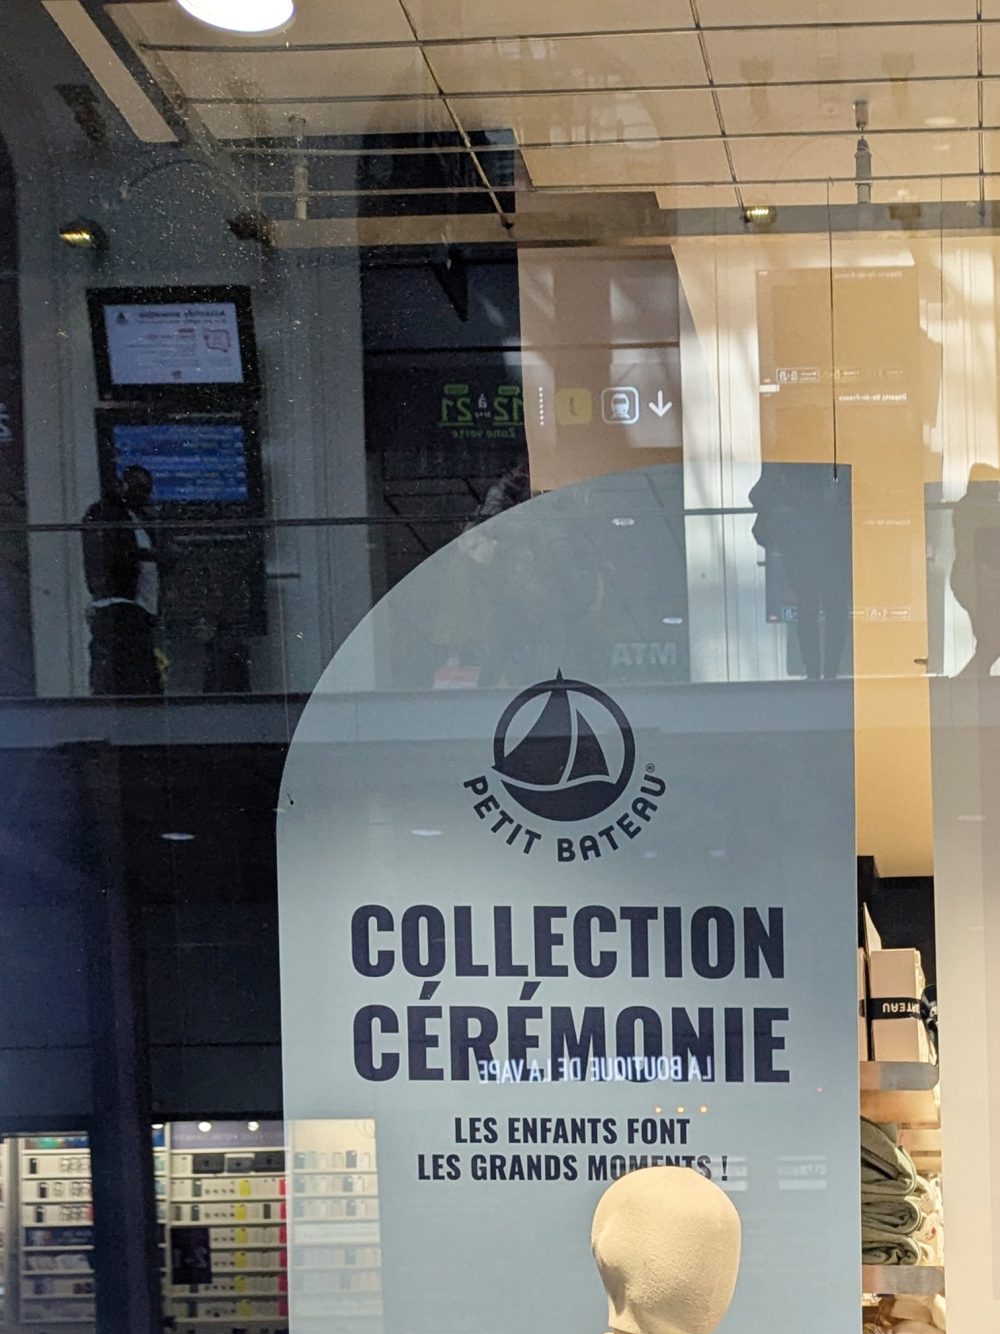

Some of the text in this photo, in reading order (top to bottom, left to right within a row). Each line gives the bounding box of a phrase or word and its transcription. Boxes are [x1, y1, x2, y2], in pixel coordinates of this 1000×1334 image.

[463, 775, 542, 854] PETIT
[350, 904, 785, 979] COLLECTION
[353, 981, 790, 1084] CÉRÉMONIE
[418, 1154, 467, 1181] LES
[471, 1153, 578, 1181] GRANDS
[455, 1116, 690, 1146] LES ENFANTS FONT
